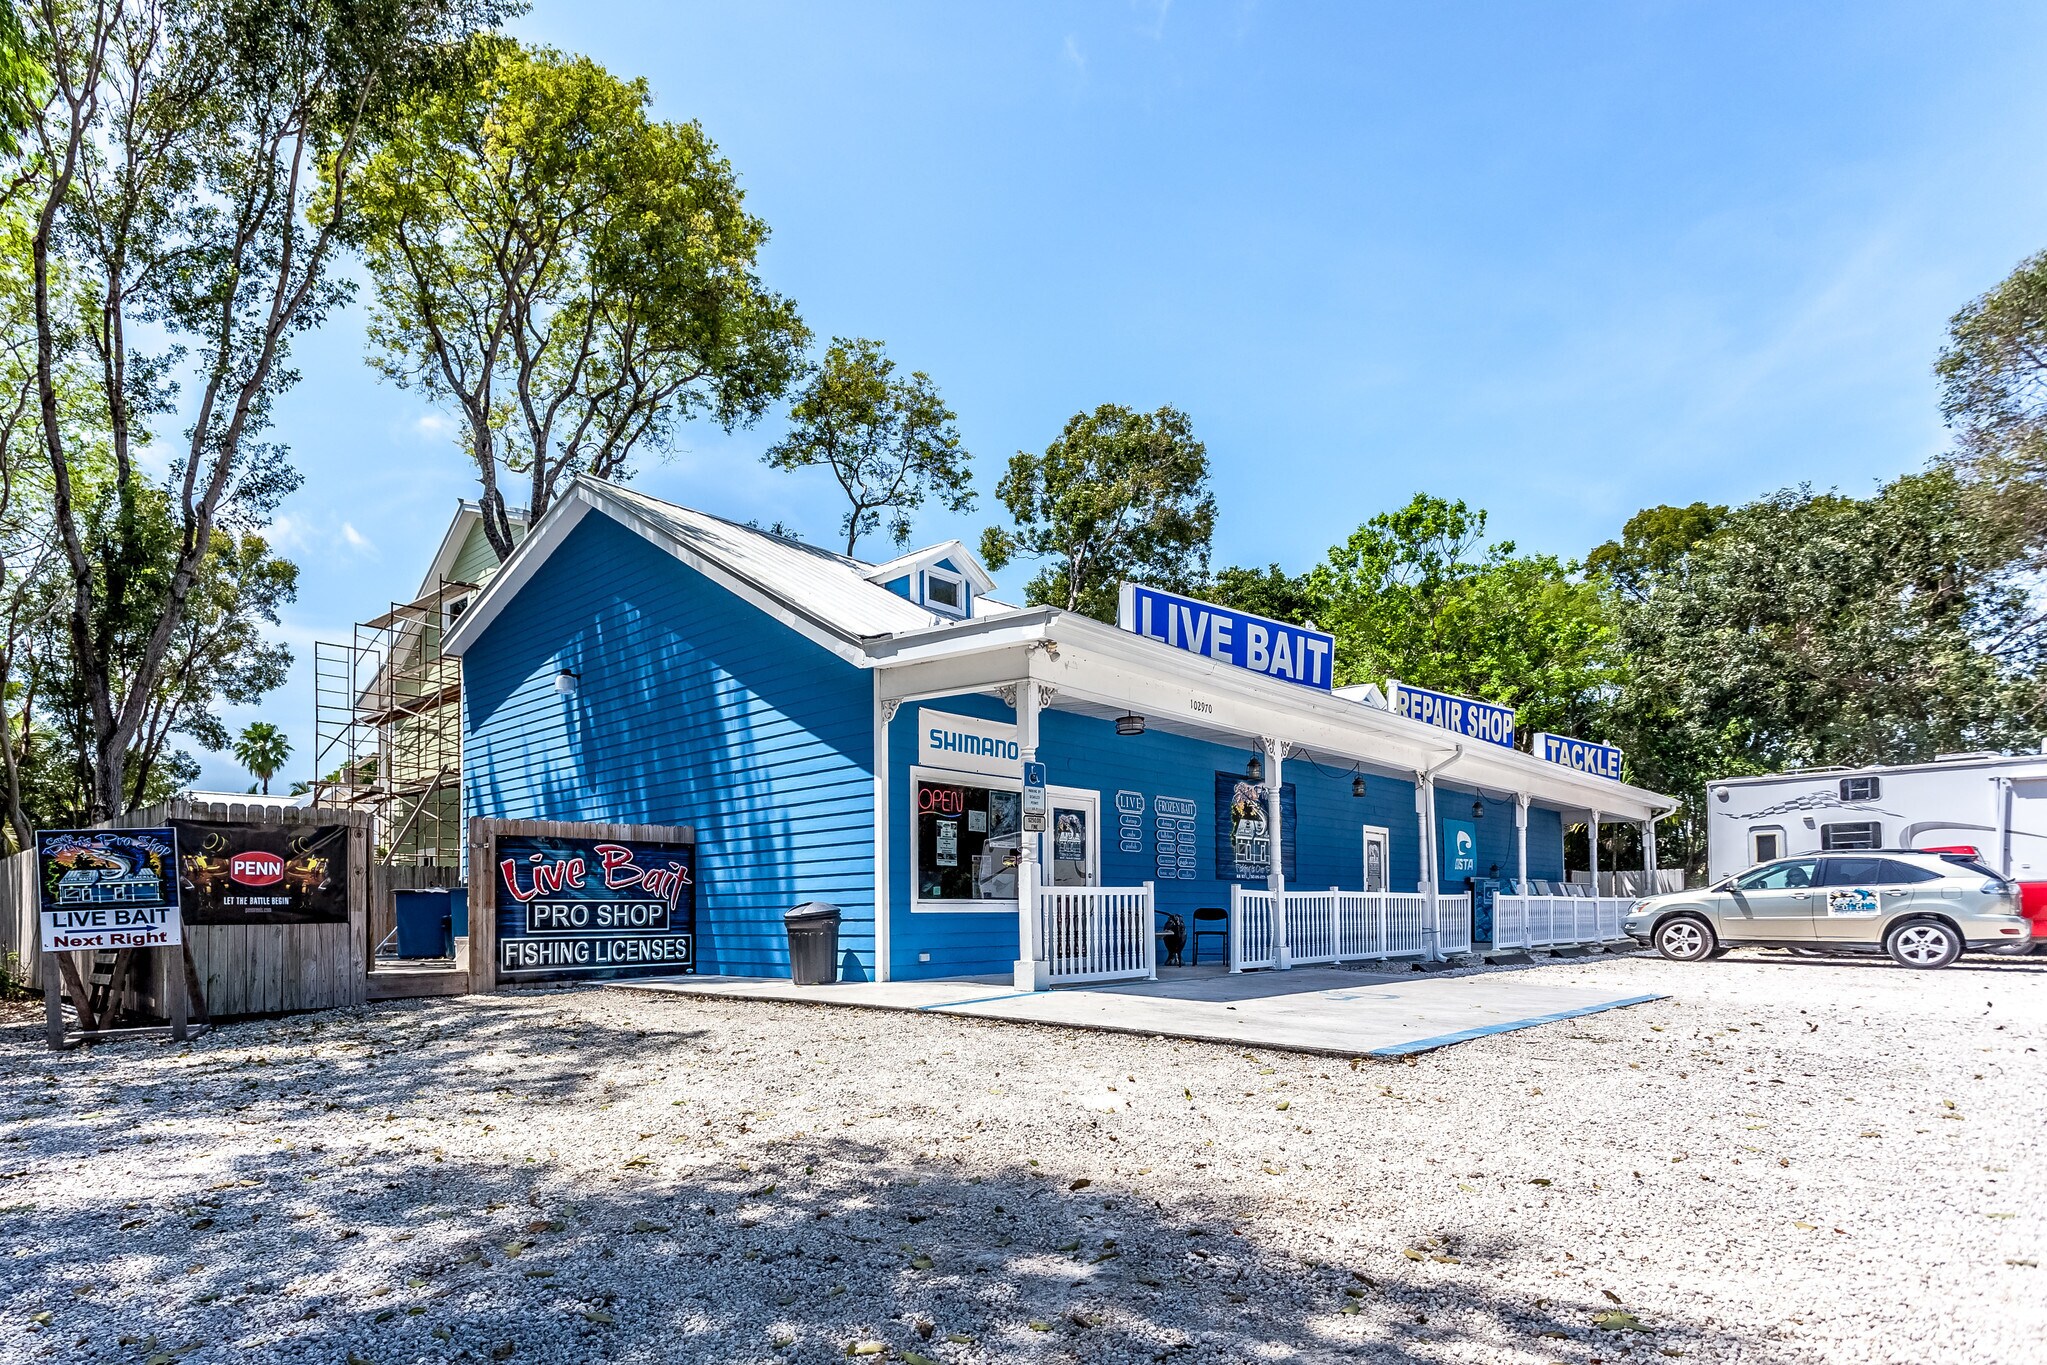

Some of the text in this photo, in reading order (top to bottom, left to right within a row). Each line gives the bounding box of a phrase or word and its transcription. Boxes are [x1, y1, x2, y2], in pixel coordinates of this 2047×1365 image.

[1142, 596, 1329, 684] LIVE BAIT
[1190, 698, 1213, 714] 102970
[1398, 690, 1514, 744] REPAIR SHOP
[929, 728, 1019, 761] SHIMANO
[1548, 738, 1618, 777] TACKLE
[918, 788, 964, 813] OPEN
[1120, 795, 1142, 809] LIVE
[1158, 799, 1194, 815] FROZEN BAIT
[234, 861, 281, 876] PENN
[500, 843, 693, 911] Live Bait
[223, 896, 235, 905] LET
[236, 896, 248, 905] THE
[249, 896, 271, 905] BATTLE
[52, 908, 171, 928] LIVE BAIT
[534, 903, 664, 928] PRO SHOP
[53, 931, 168, 948] Next Right
[505, 938, 687, 967] FISHING LICENSES
